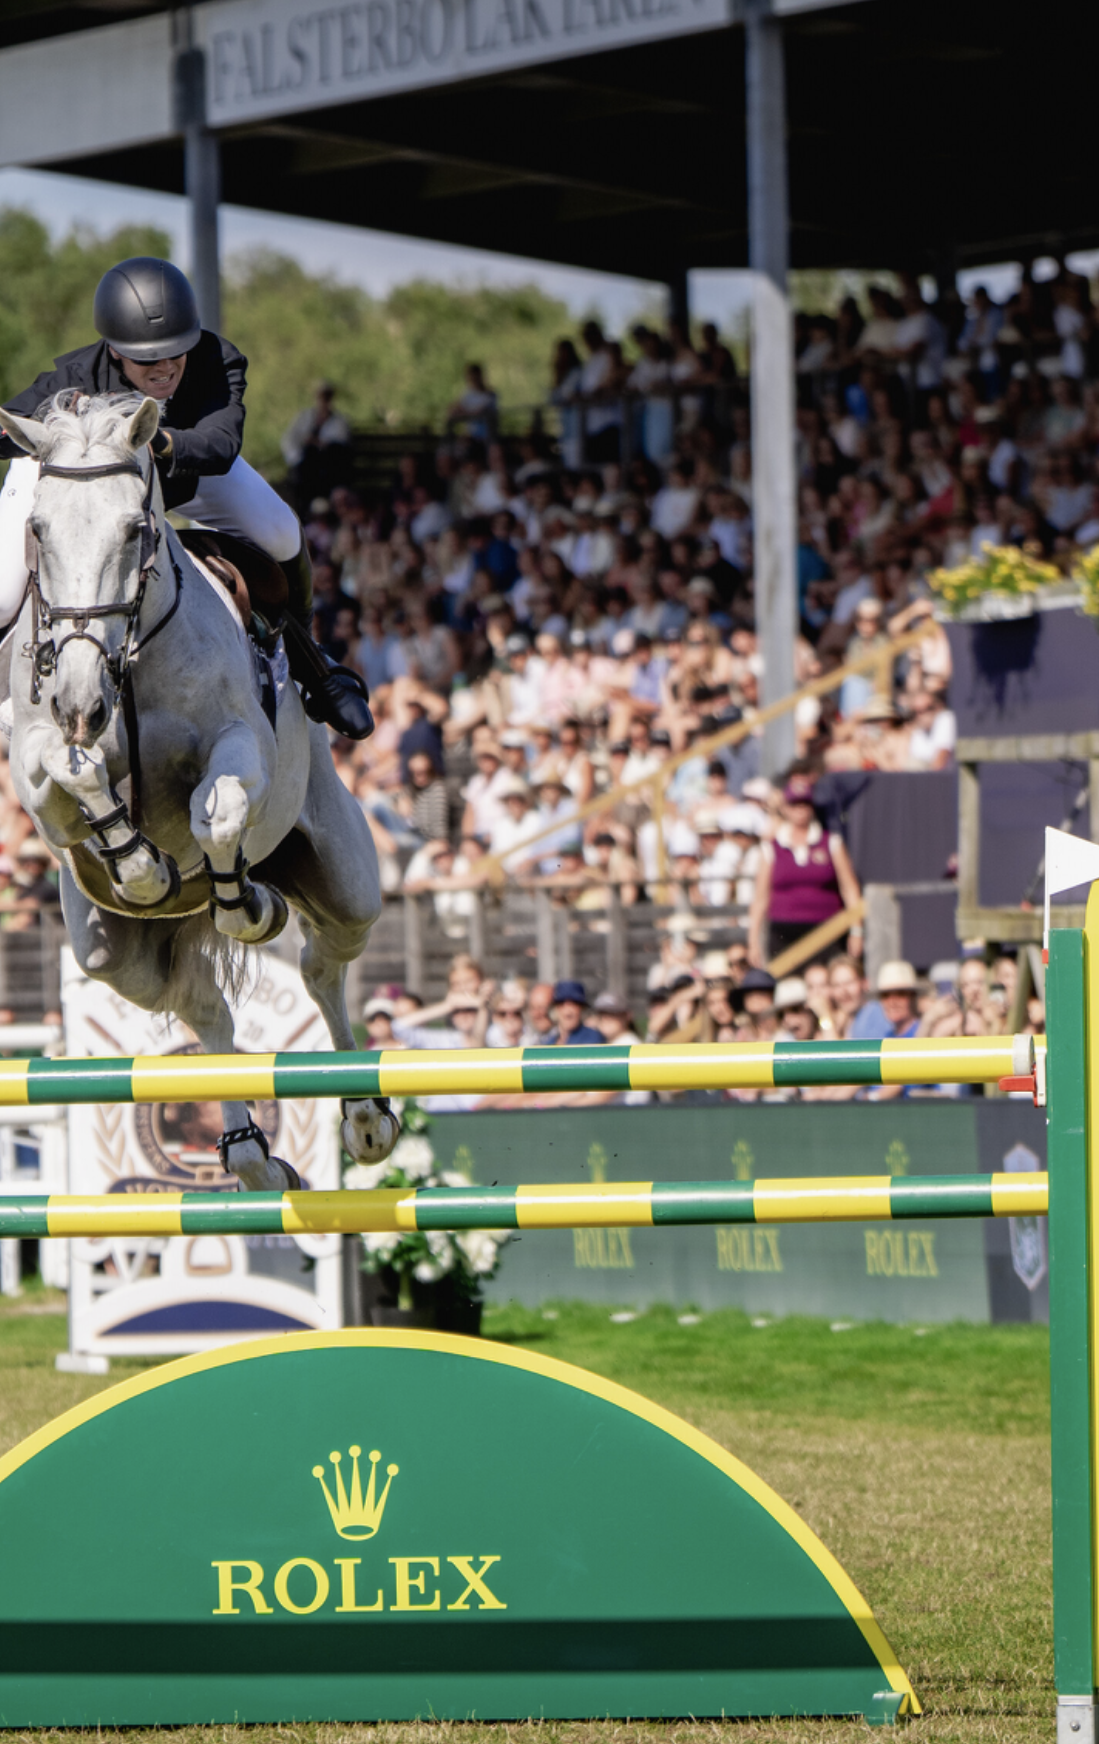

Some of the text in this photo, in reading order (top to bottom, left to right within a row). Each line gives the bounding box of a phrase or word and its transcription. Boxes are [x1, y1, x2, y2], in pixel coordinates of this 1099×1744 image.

[572, 1228, 635, 1269] ROLEX
[715, 1228, 783, 1273] ROLEX
[864, 1229, 938, 1278] ROLEX
[211, 1555, 508, 1615] ROLEX
